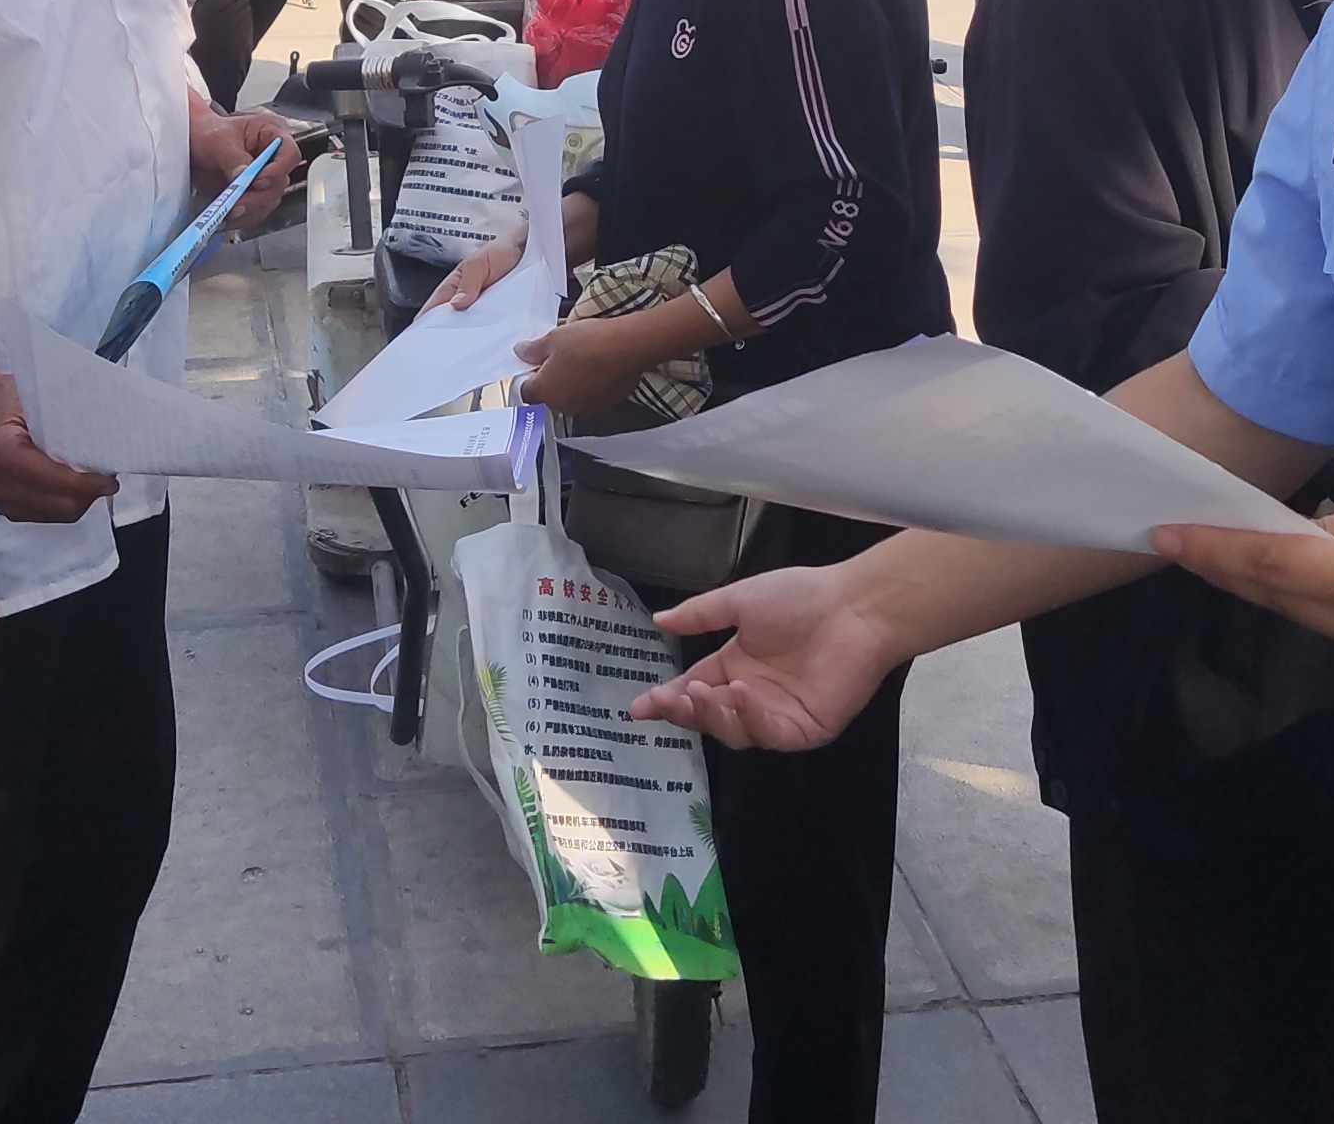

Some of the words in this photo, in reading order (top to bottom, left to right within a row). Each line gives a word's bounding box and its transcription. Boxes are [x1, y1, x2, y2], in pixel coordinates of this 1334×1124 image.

[537, 577, 650, 616] 高铁安全九不
